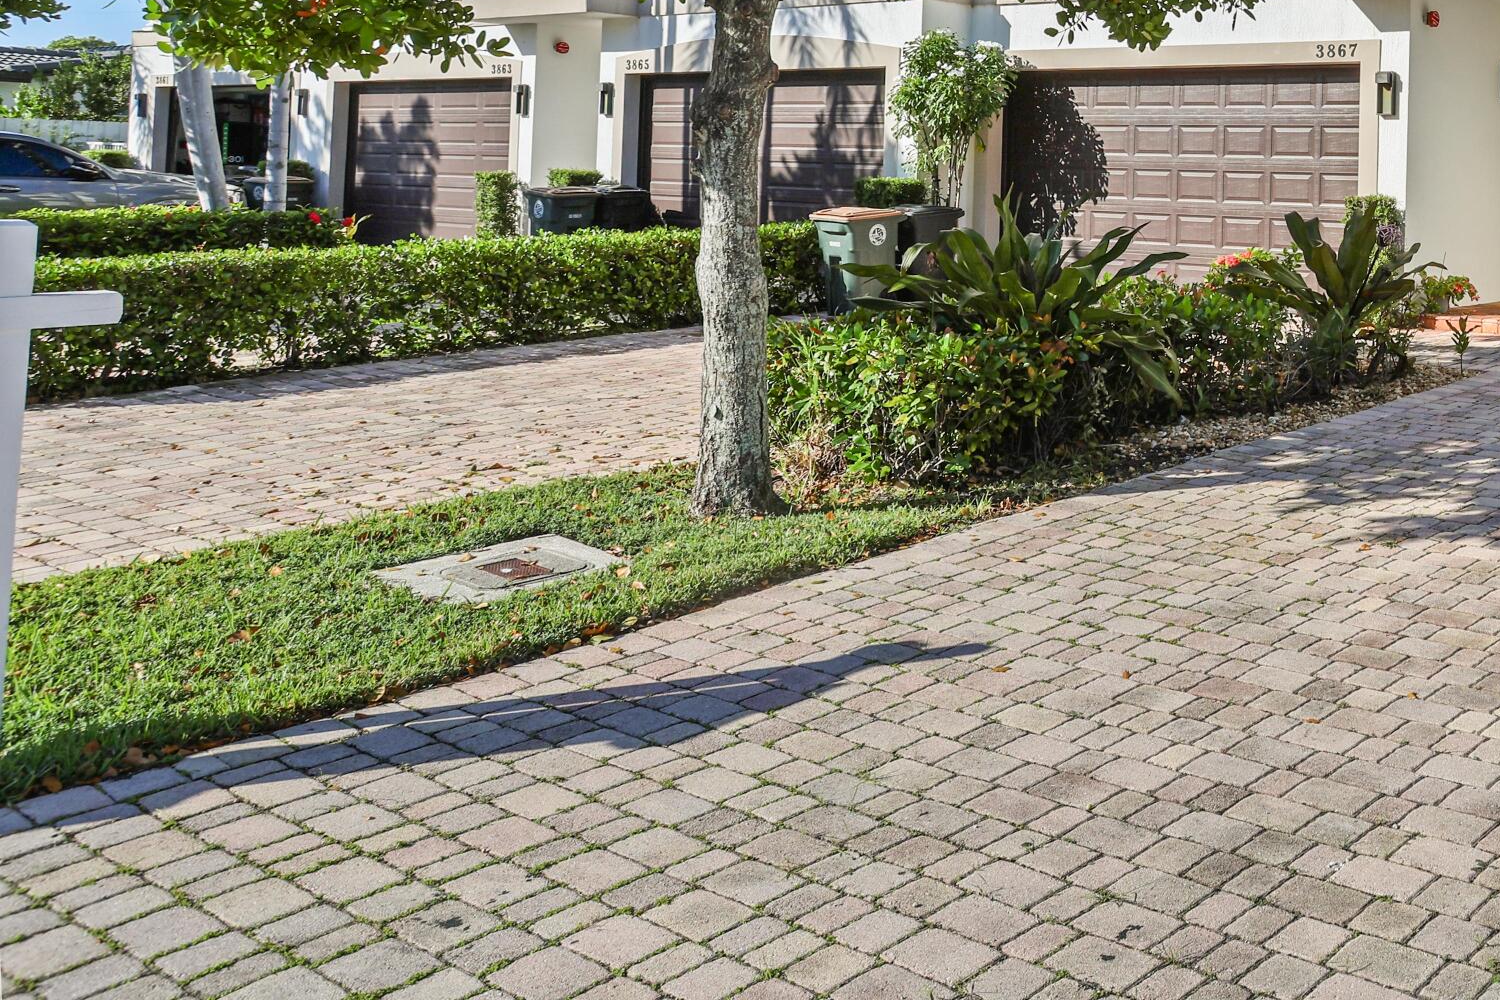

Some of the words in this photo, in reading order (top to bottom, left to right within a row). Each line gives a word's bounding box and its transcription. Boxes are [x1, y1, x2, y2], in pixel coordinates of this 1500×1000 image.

[1315, 43, 1358, 58] 3867
[491, 63, 512, 74] 3863
[625, 58, 650, 70] 3865
